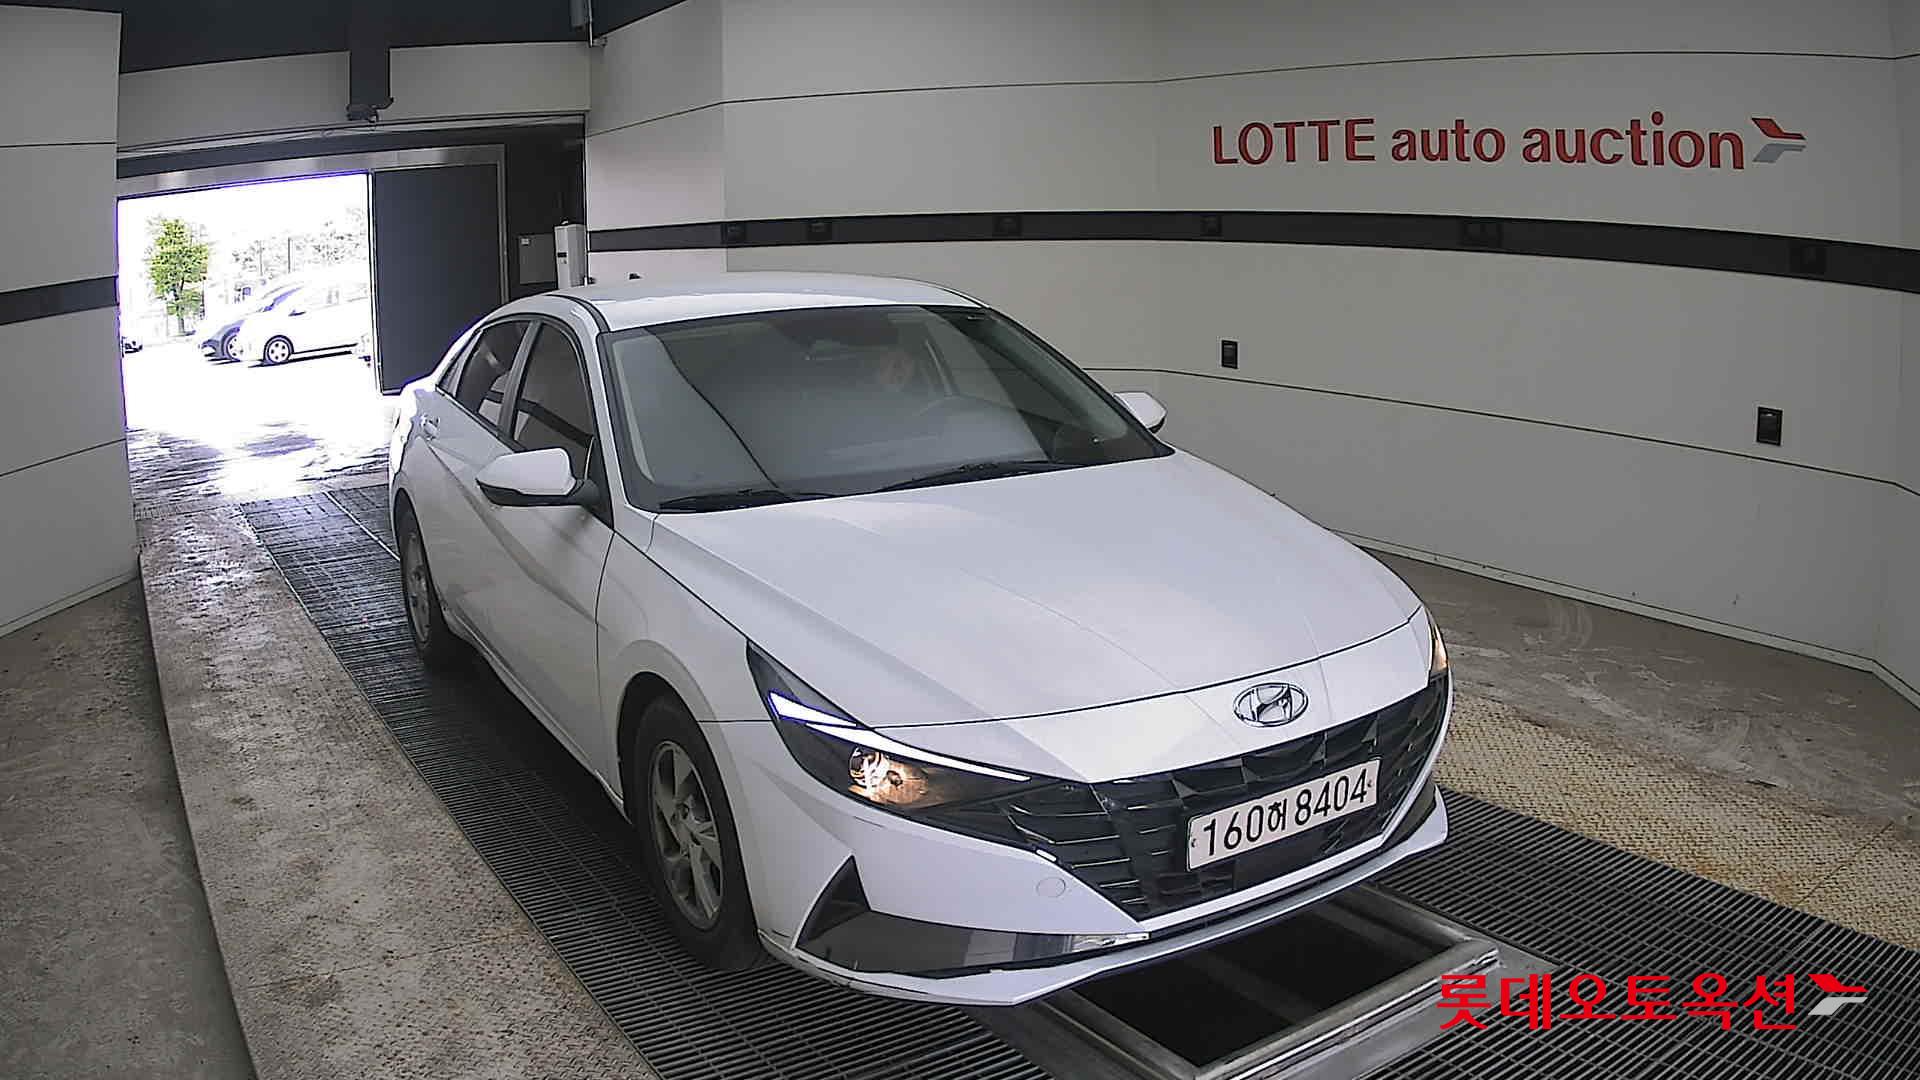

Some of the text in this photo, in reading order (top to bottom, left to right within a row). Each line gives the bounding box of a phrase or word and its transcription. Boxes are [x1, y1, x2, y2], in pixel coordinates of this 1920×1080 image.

[1213, 112, 1745, 169] LOTTE auto auction
[1295, 768, 1367, 825] 8404
